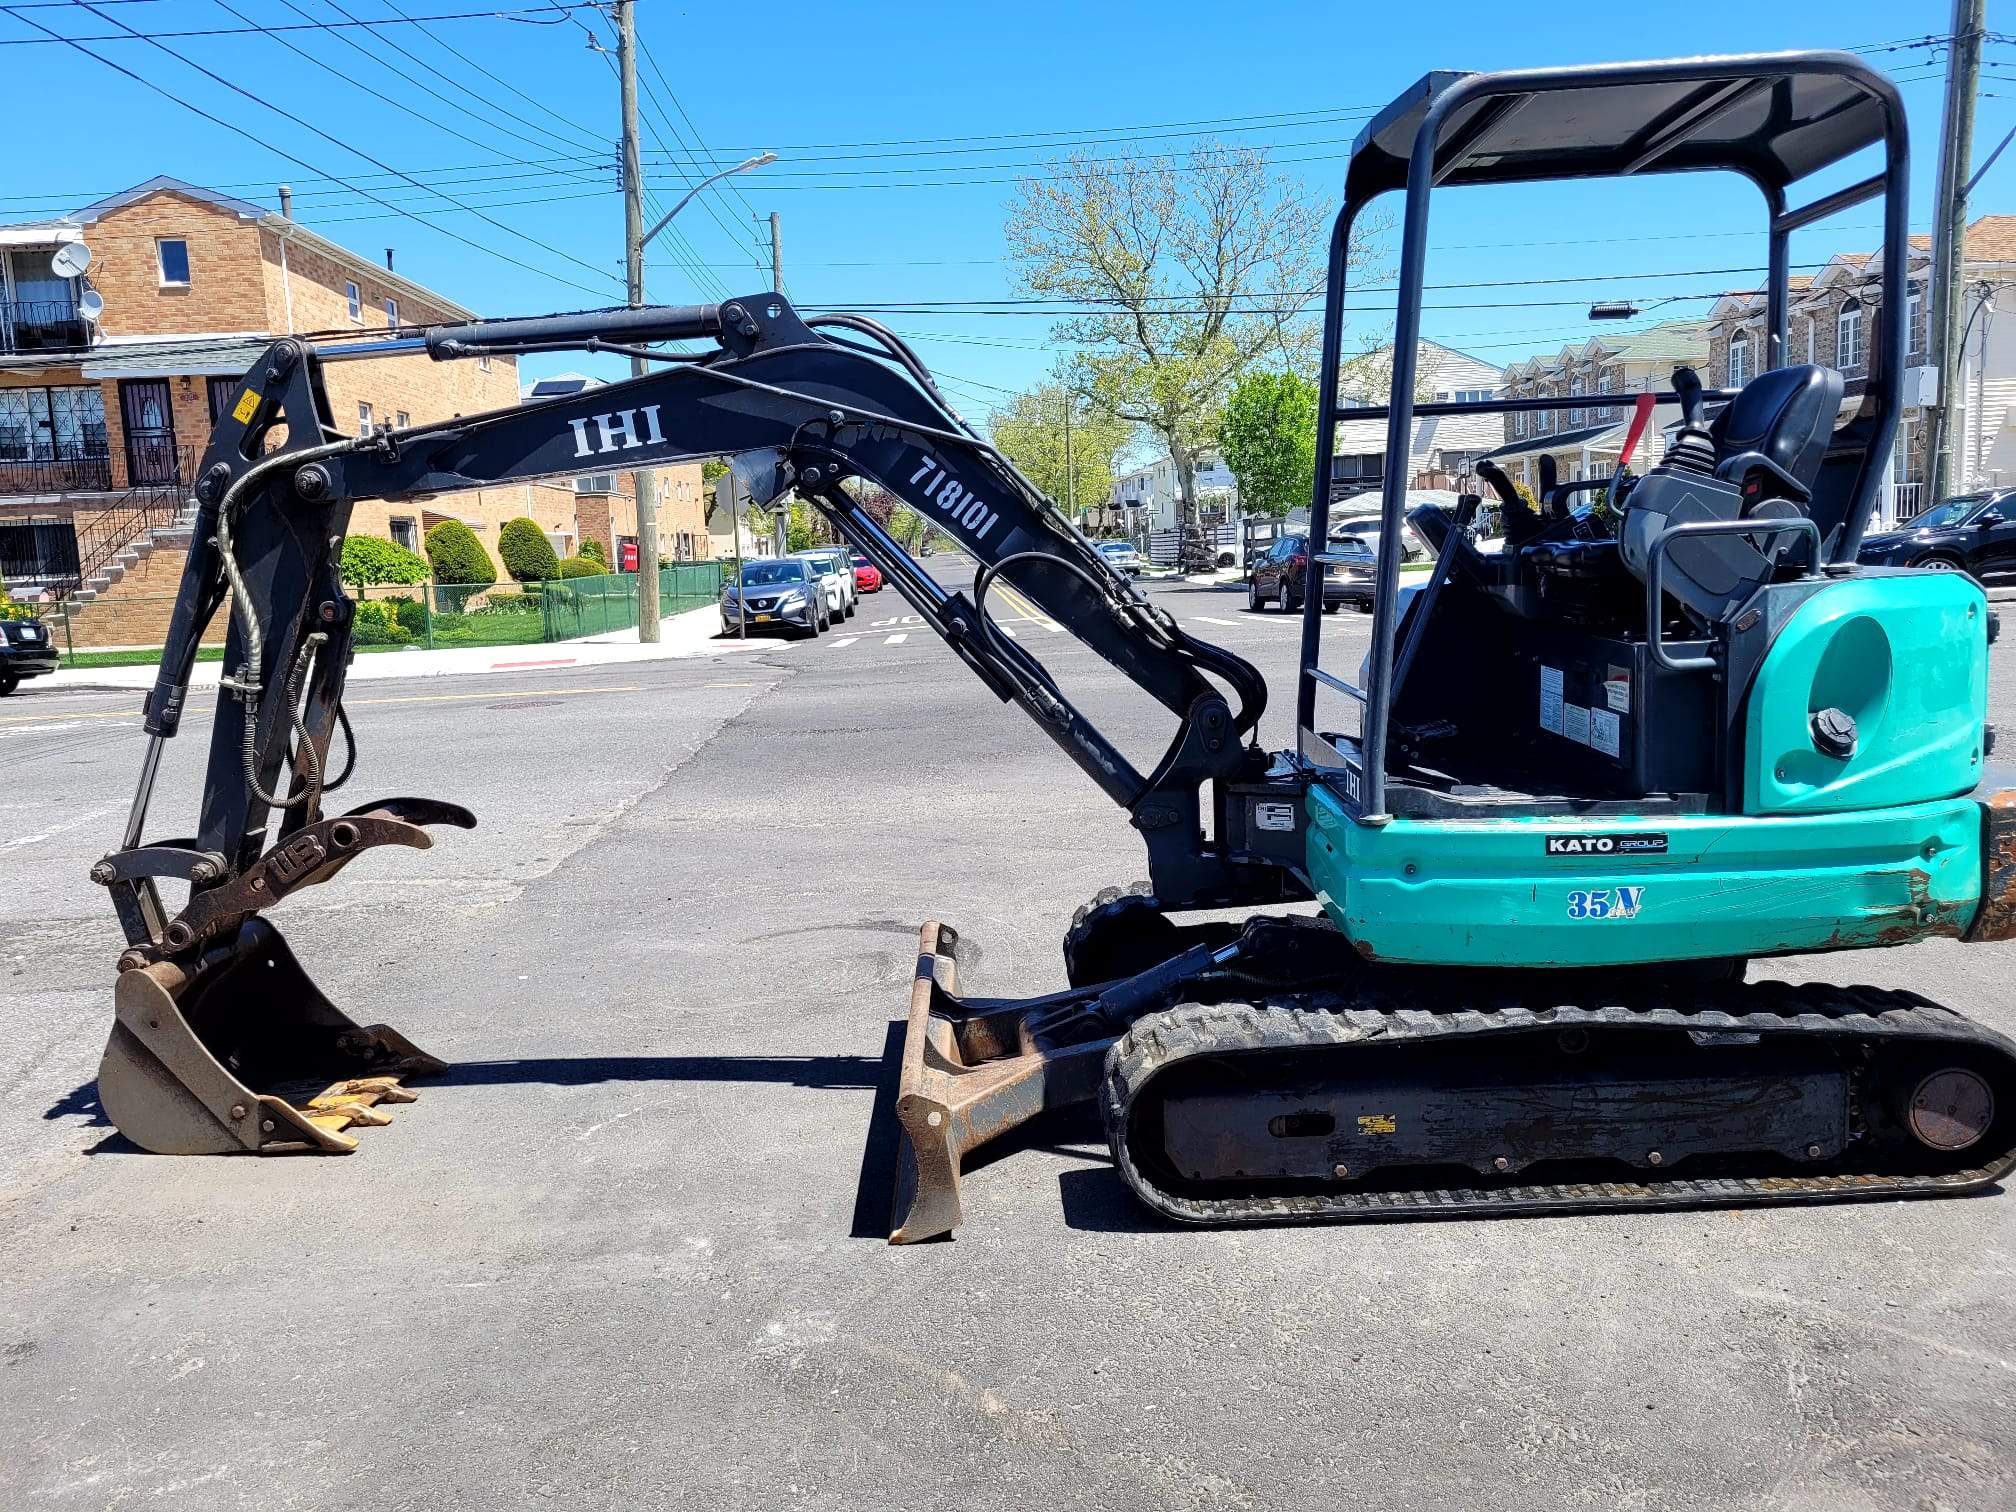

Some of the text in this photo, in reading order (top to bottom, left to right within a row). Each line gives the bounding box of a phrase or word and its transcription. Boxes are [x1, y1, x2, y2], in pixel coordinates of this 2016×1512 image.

[567, 404, 668, 458] IHI
[909, 455, 1000, 540] 718101
[1549, 839, 1614, 852] KATO
[1619, 839, 1666, 849] GROUP
